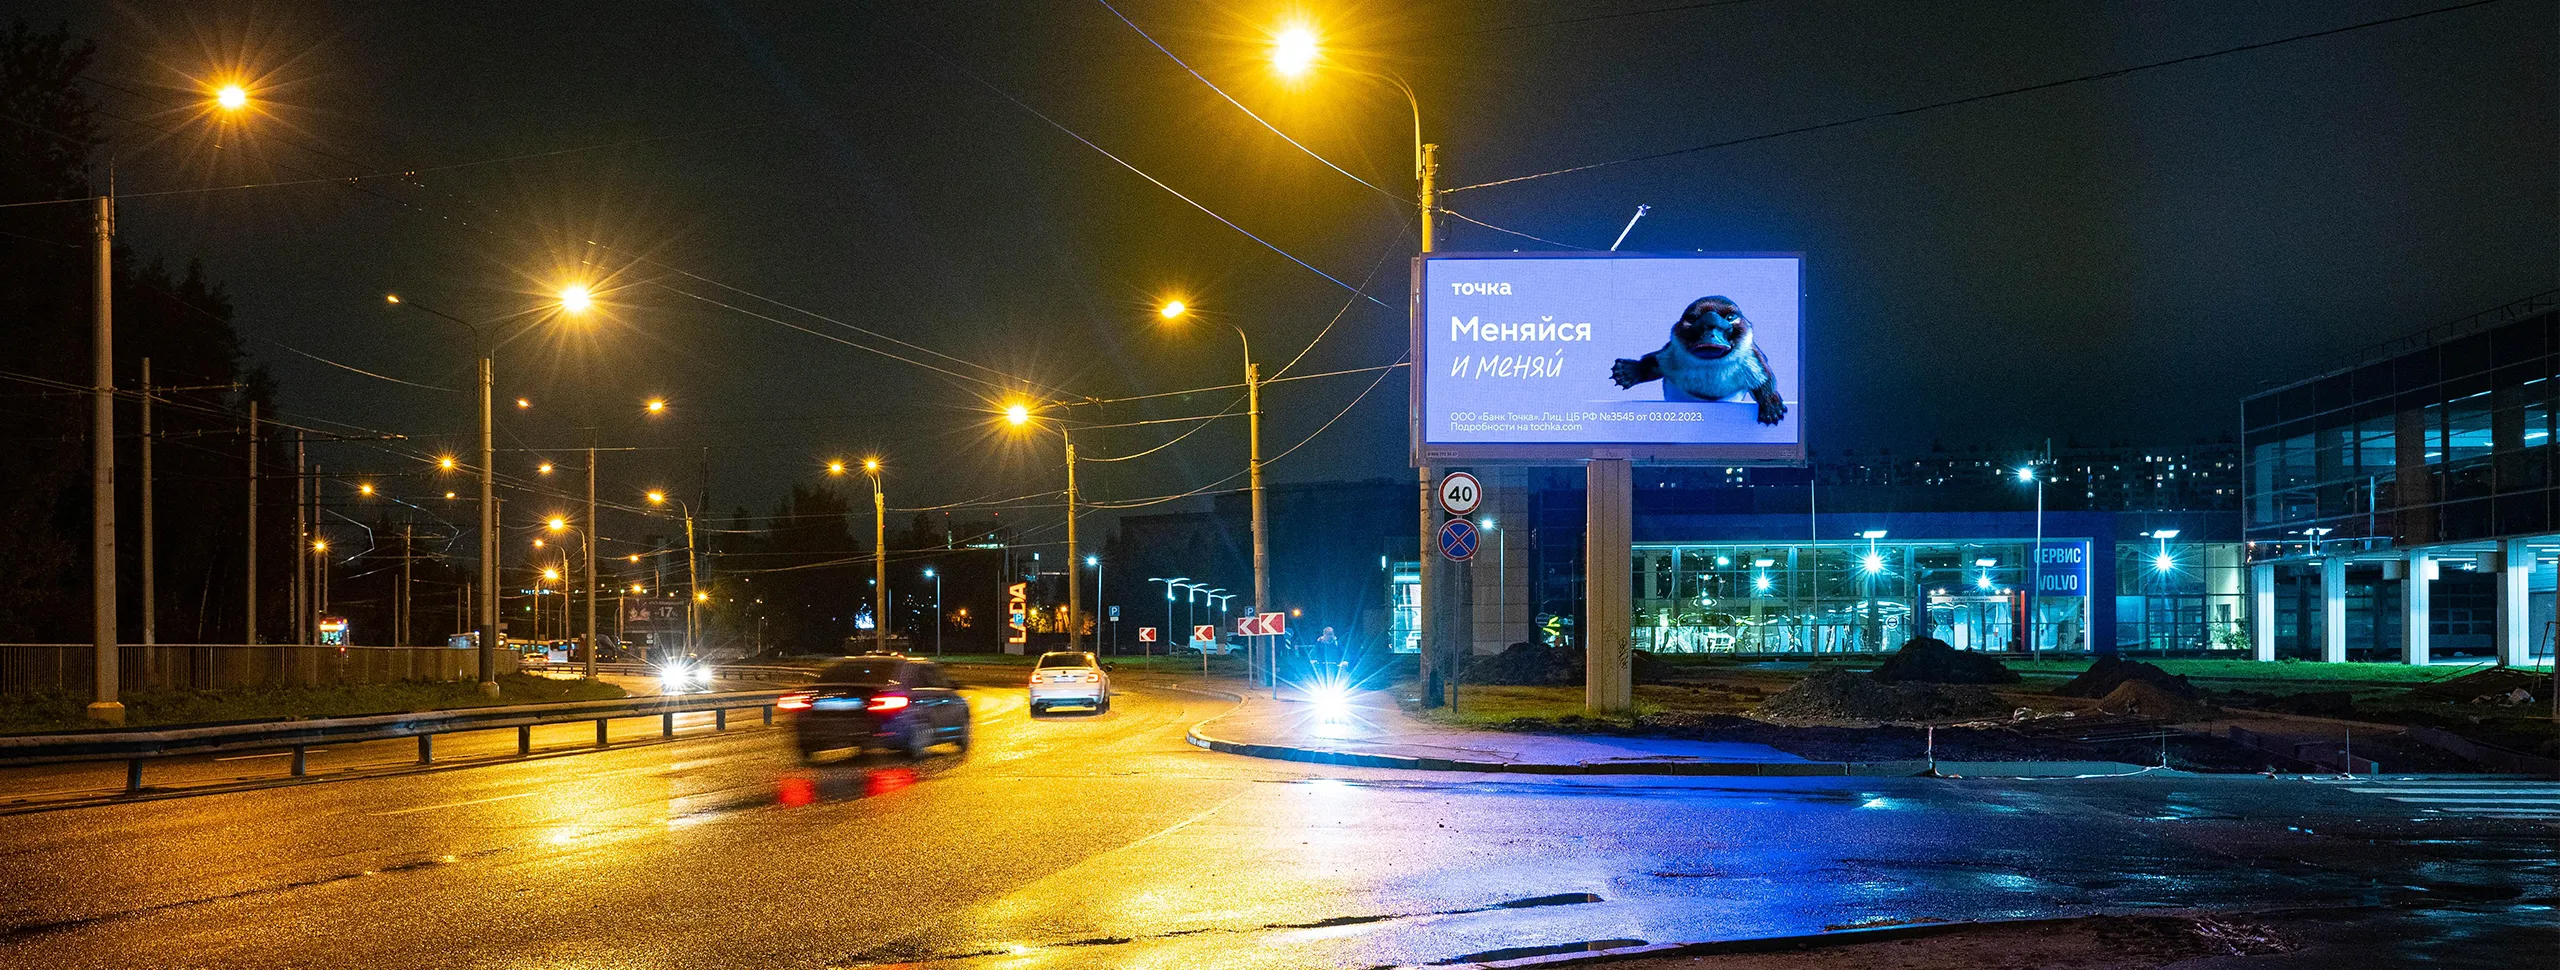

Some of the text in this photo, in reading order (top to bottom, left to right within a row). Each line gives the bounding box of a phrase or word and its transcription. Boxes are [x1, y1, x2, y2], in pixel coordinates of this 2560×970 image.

[1451, 282, 1512, 296] точка
[1451, 315, 1591, 341] Меняйся
[1450, 348, 1564, 380] и меняй
[1450, 412, 1476, 421] ООО
[1477, 412, 1506, 421] «Банк
[1507, 412, 1540, 421] Точка».
[1541, 412, 1563, 422] Лиц.
[1565, 412, 1580, 422] ЦБ
[1582, 412, 1598, 421] РФ
[1599, 412, 1635, 421] №3545
[1648, 412, 1705, 422] 03.02.2023.
[1450, 421, 1583, 433] Подробности на tochka.com
[1448, 486, 1472, 502] 40
[2039, 574, 2078, 590] VOLVO
